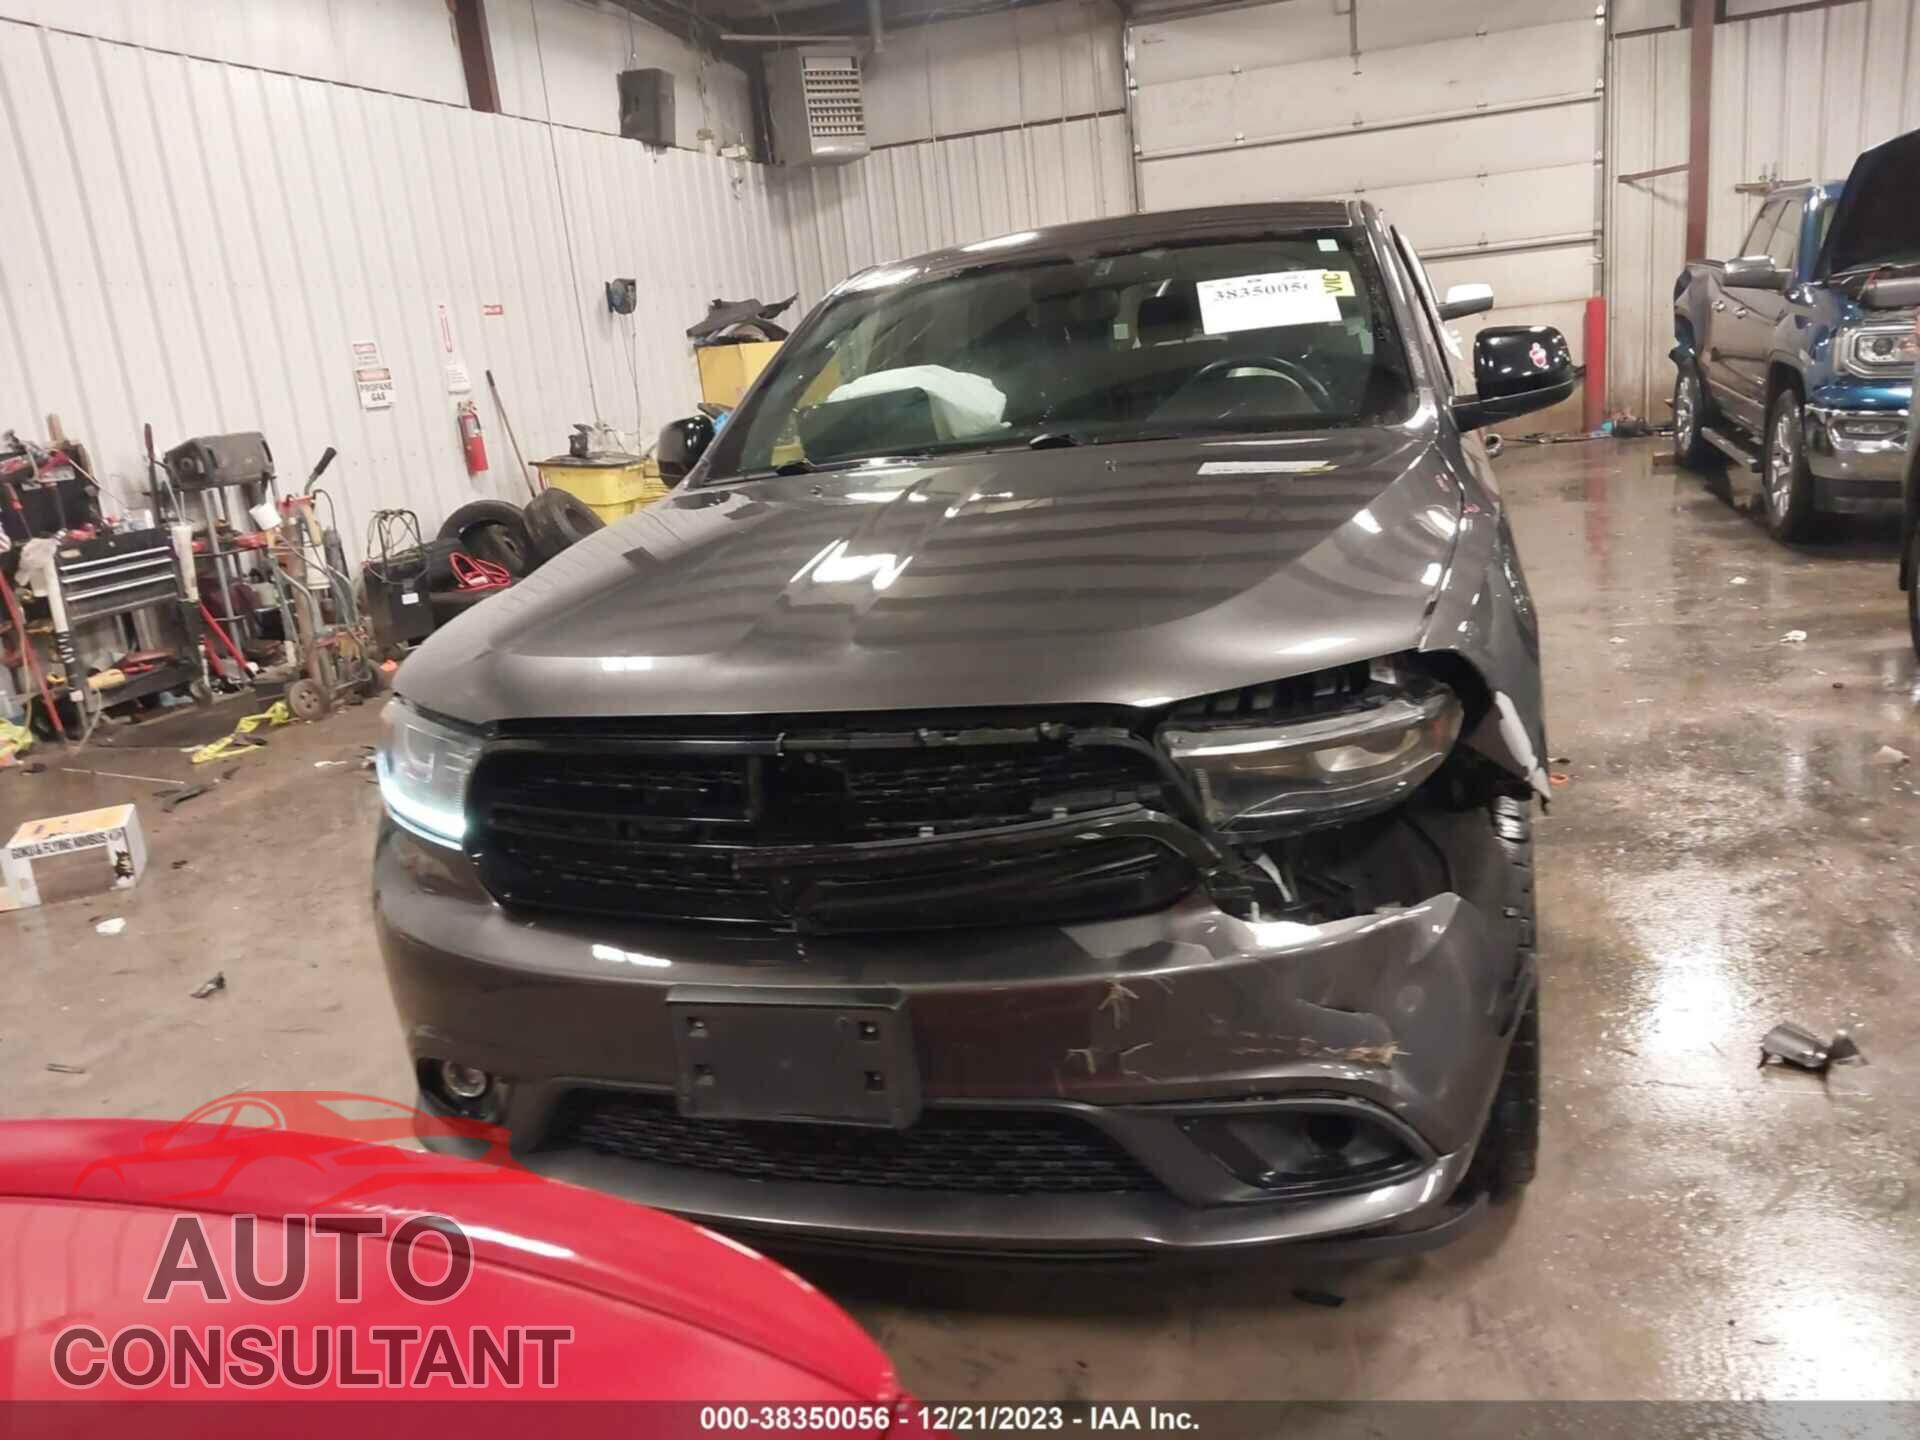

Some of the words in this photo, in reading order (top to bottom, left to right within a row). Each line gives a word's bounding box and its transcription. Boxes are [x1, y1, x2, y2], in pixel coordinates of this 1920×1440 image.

[1322, 273, 1343, 293] VIC
[360, 382, 393, 392] PROPANE
[371, 392, 386, 401] GAS
